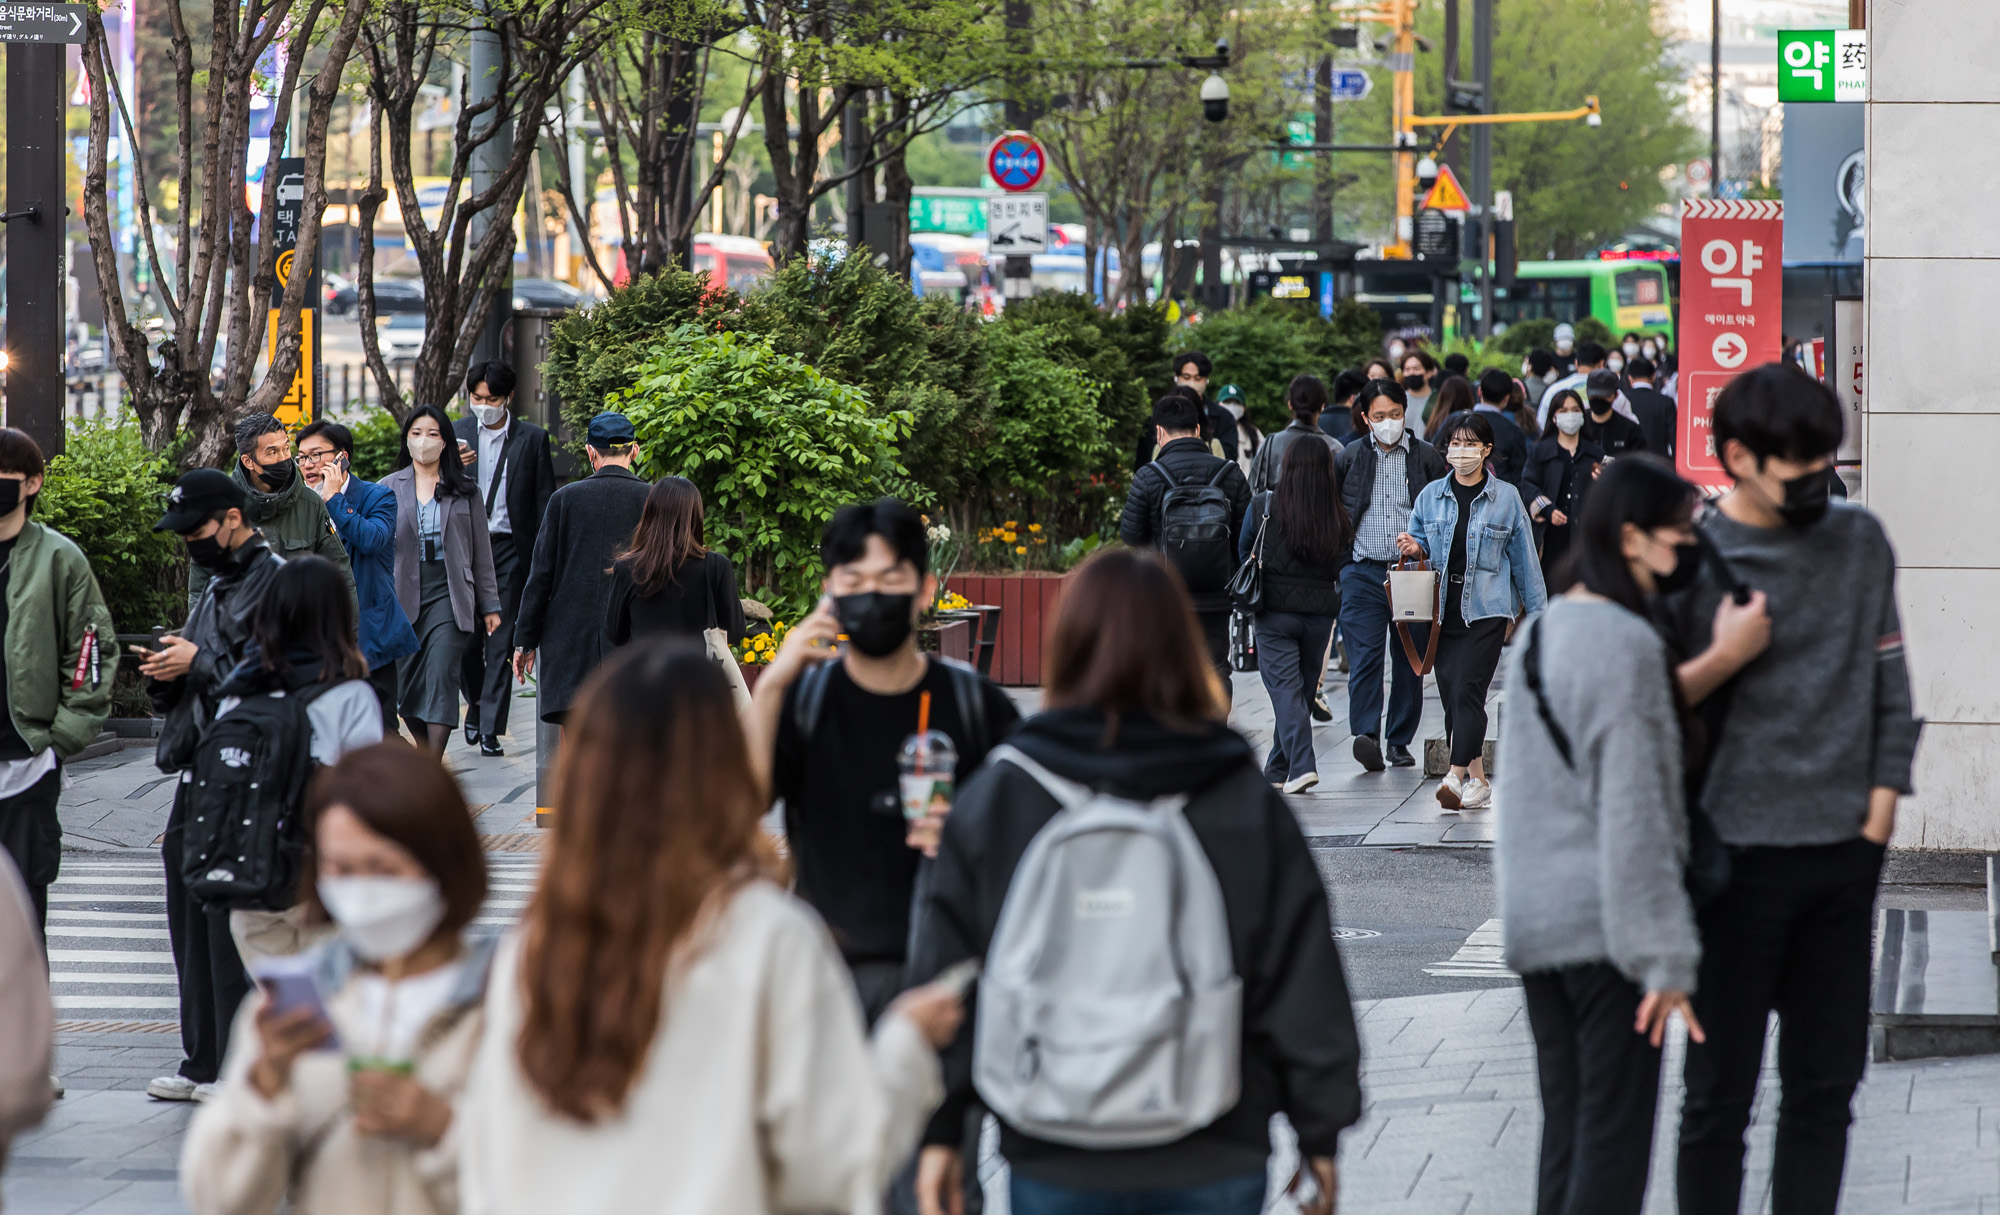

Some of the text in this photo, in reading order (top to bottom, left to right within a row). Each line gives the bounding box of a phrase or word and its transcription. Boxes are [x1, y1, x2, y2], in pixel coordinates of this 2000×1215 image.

[0, 6, 54, 21] 음식문화거리
[1784, 41, 1830, 90] 약
[277, 210, 301, 227] 택
[277, 230, 297, 242] TA
[1701, 239, 1763, 307] 약
